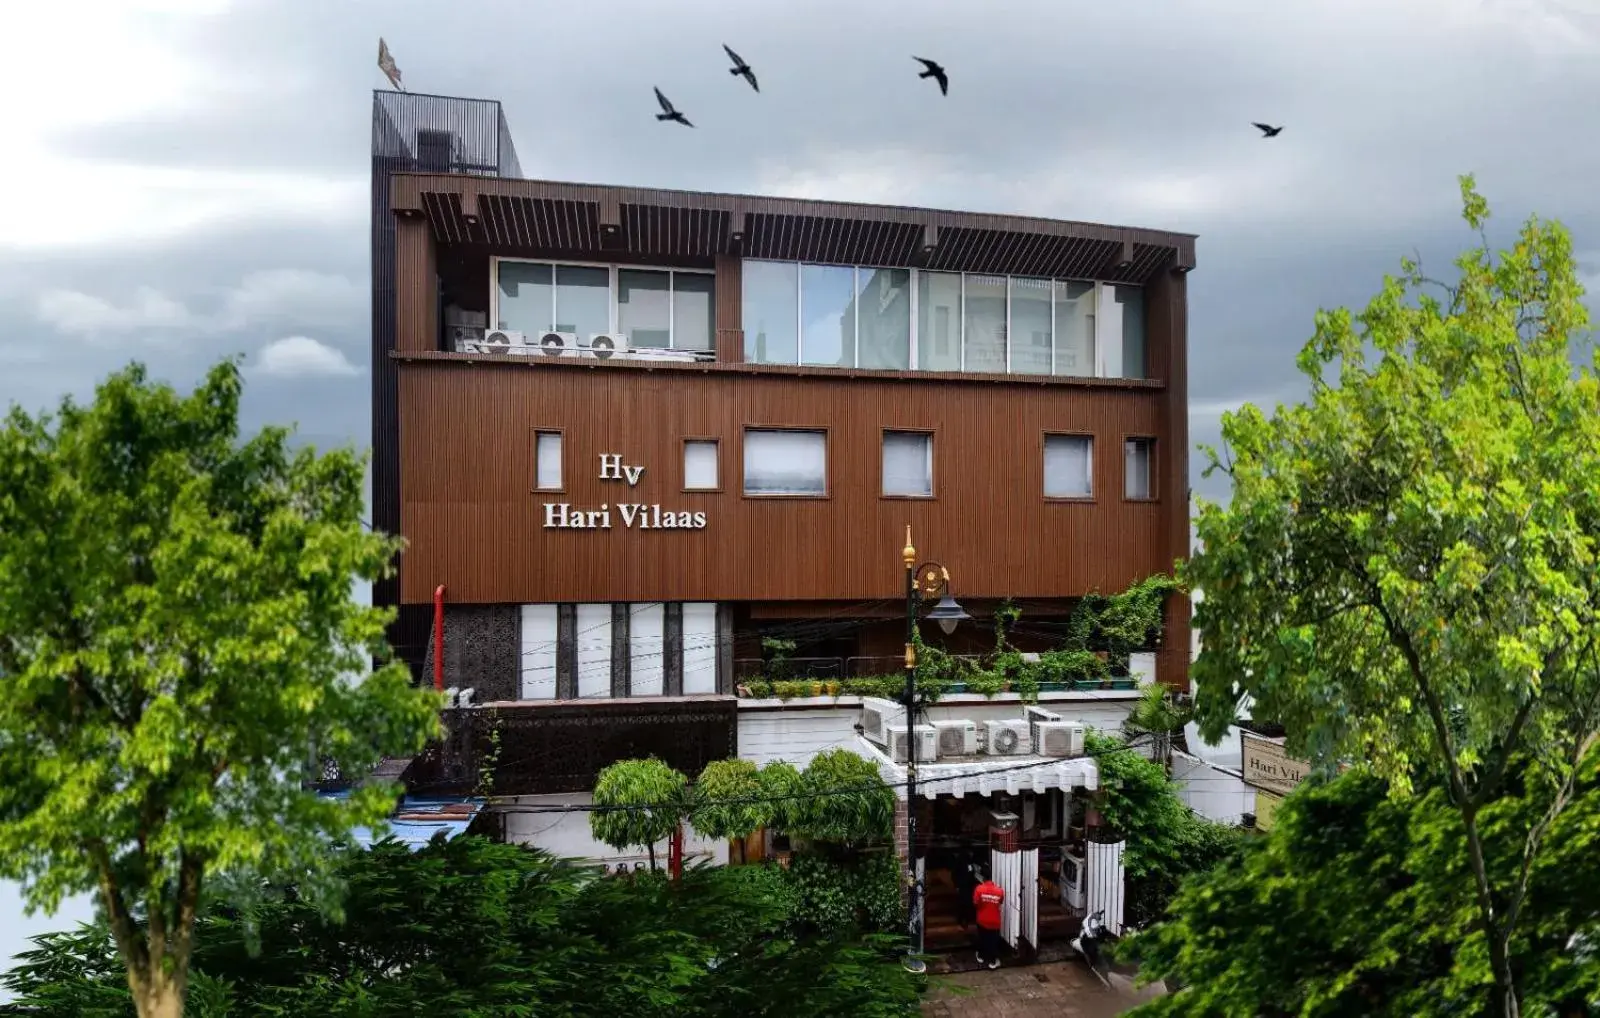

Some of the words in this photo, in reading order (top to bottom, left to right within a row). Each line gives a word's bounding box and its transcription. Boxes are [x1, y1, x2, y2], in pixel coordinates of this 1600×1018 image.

[543, 503, 612, 528] Hari
[617, 503, 707, 528] Vilaas
[1250, 757, 1277, 776] Hari
